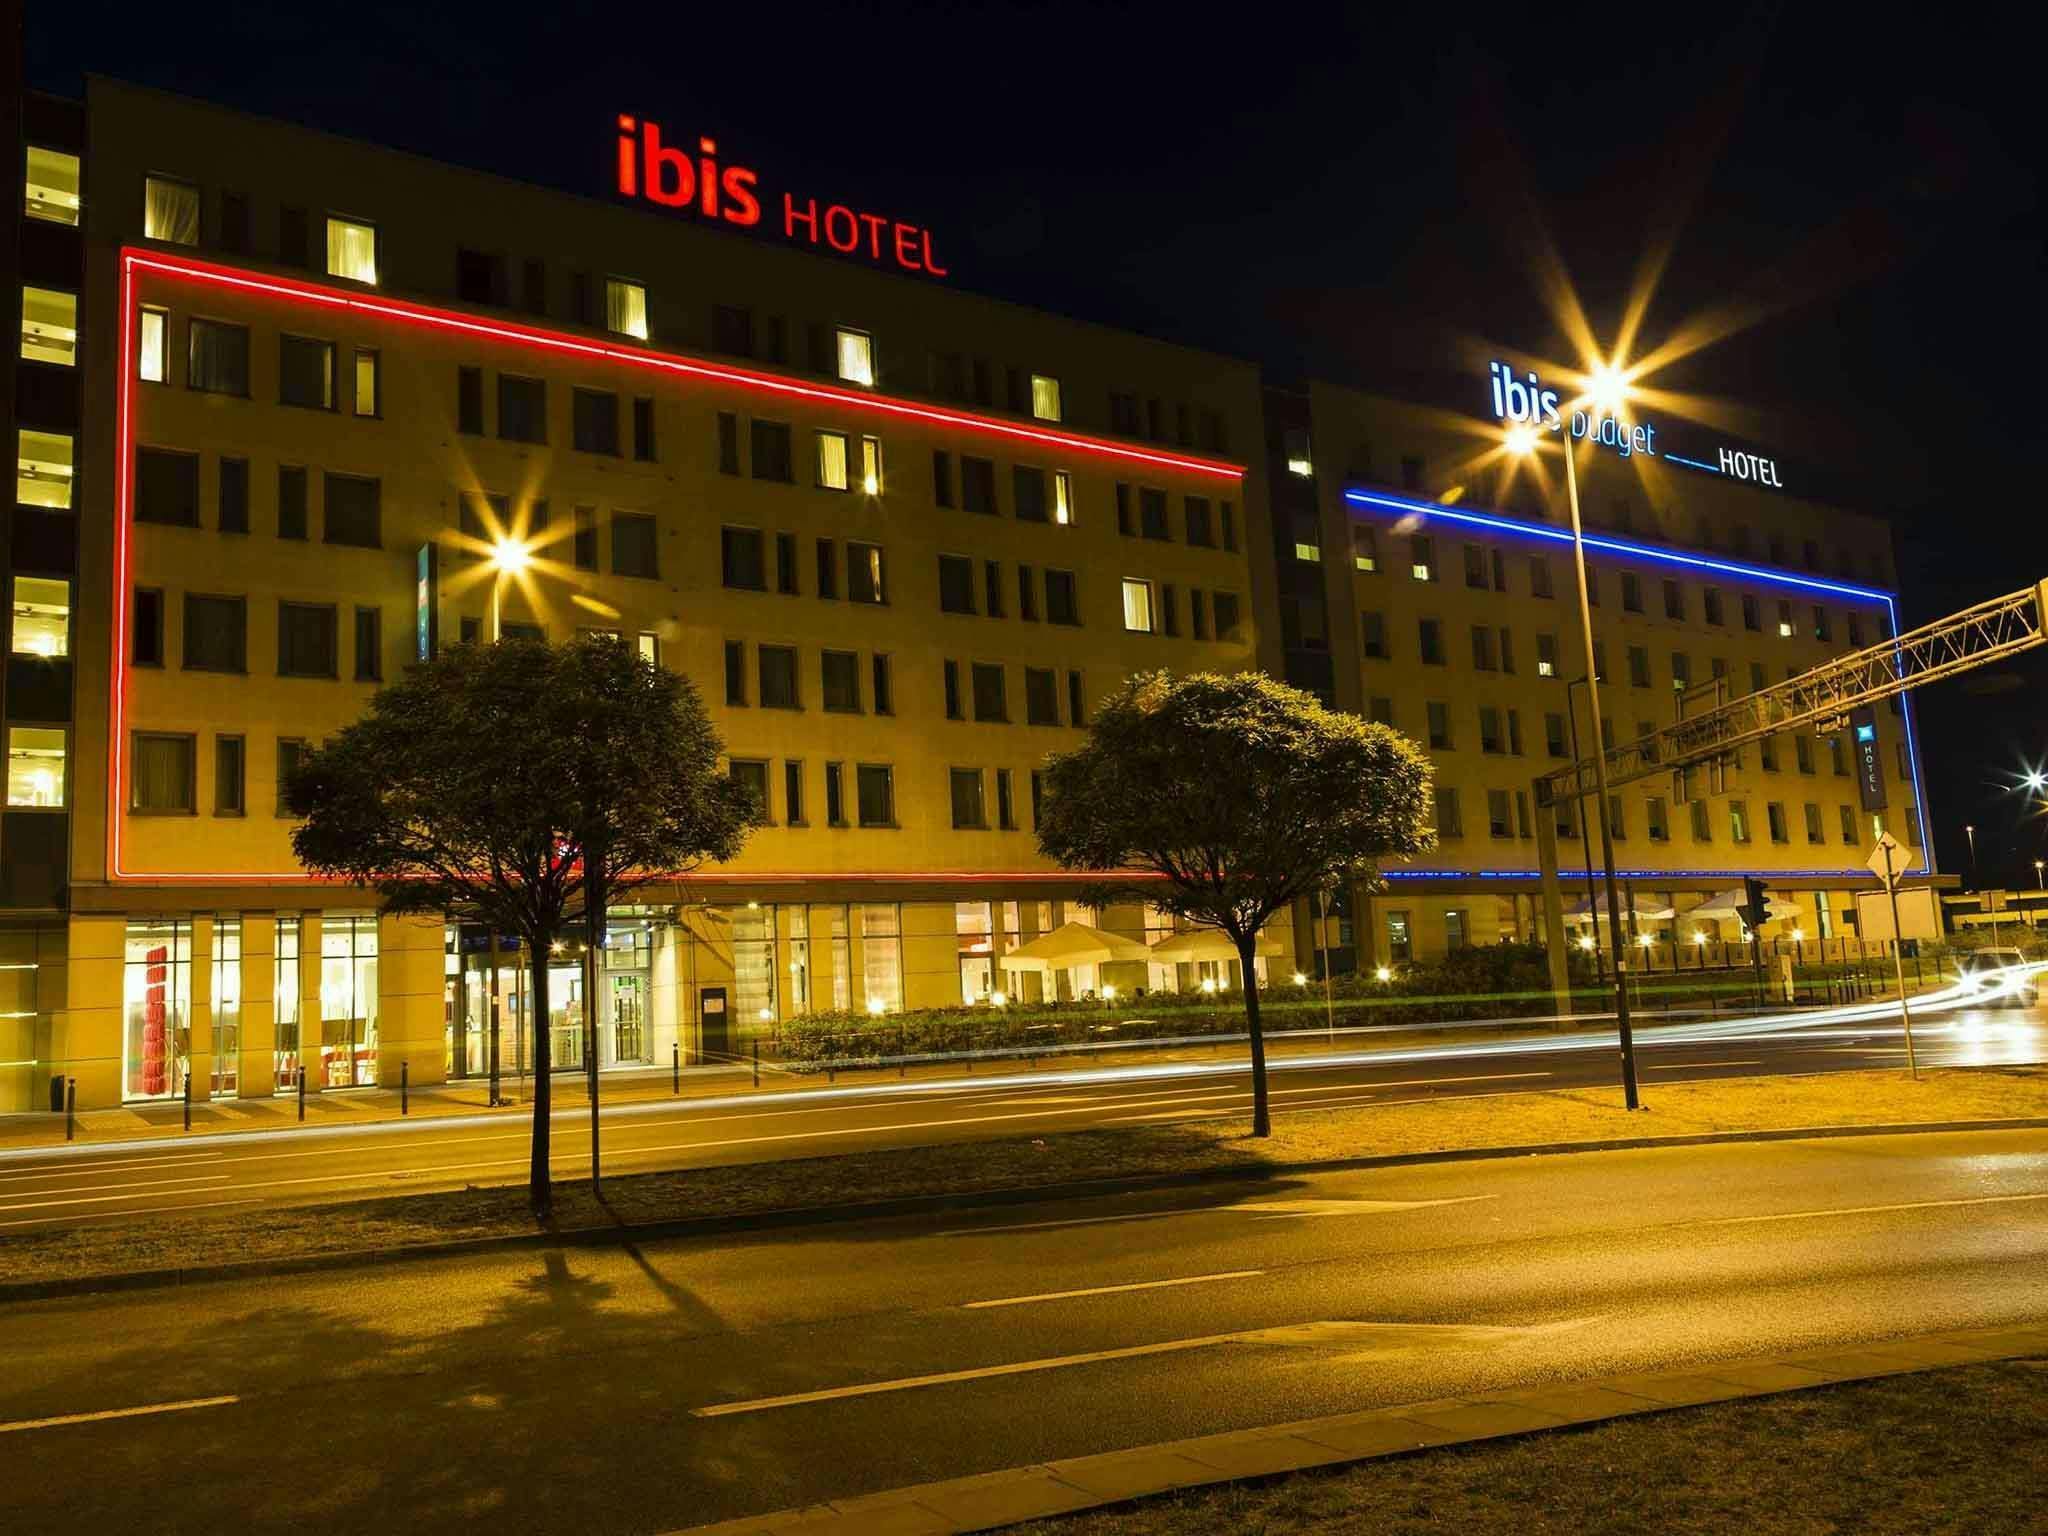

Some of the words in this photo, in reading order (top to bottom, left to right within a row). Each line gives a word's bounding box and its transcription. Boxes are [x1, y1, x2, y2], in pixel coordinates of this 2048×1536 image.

[618, 113, 761, 226] ibis
[784, 193, 947, 276] HOTEL
[1490, 361, 1561, 432] ibis
[1719, 447, 1783, 488] HOTEL
[1864, 745, 1877, 792] HOTEL
